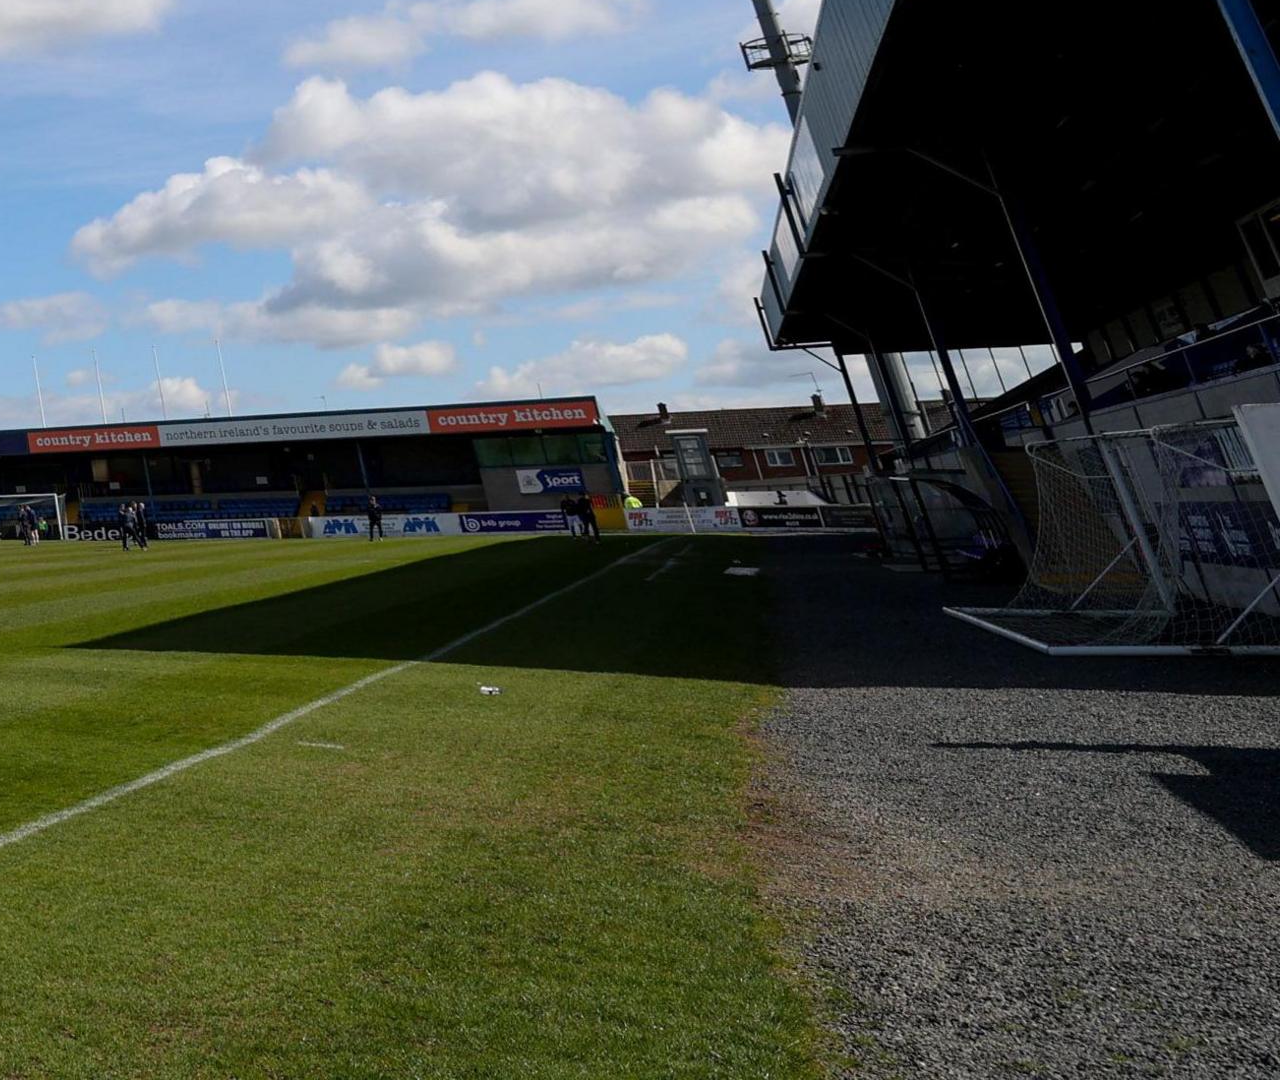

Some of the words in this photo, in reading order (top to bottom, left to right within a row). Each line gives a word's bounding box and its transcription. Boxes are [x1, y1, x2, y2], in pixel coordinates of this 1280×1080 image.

[438, 411, 508, 426] country
[513, 407, 586, 422] kitchen
[165, 429, 216, 441] northern
[218, 426, 270, 439] ireland's
[271, 423, 325, 437] favourite
[329, 421, 364, 433] soups
[367, 420, 378, 430] &
[380, 417, 420, 430] salads
[36, 434, 91, 447] country
[95, 431, 152, 443] kitchen
[156, 522, 206, 531] TOALS.COM
[498, 520, 520, 528] group
[63, 525, 133, 541] Bede
[158, 531, 206, 539] bookmakers
